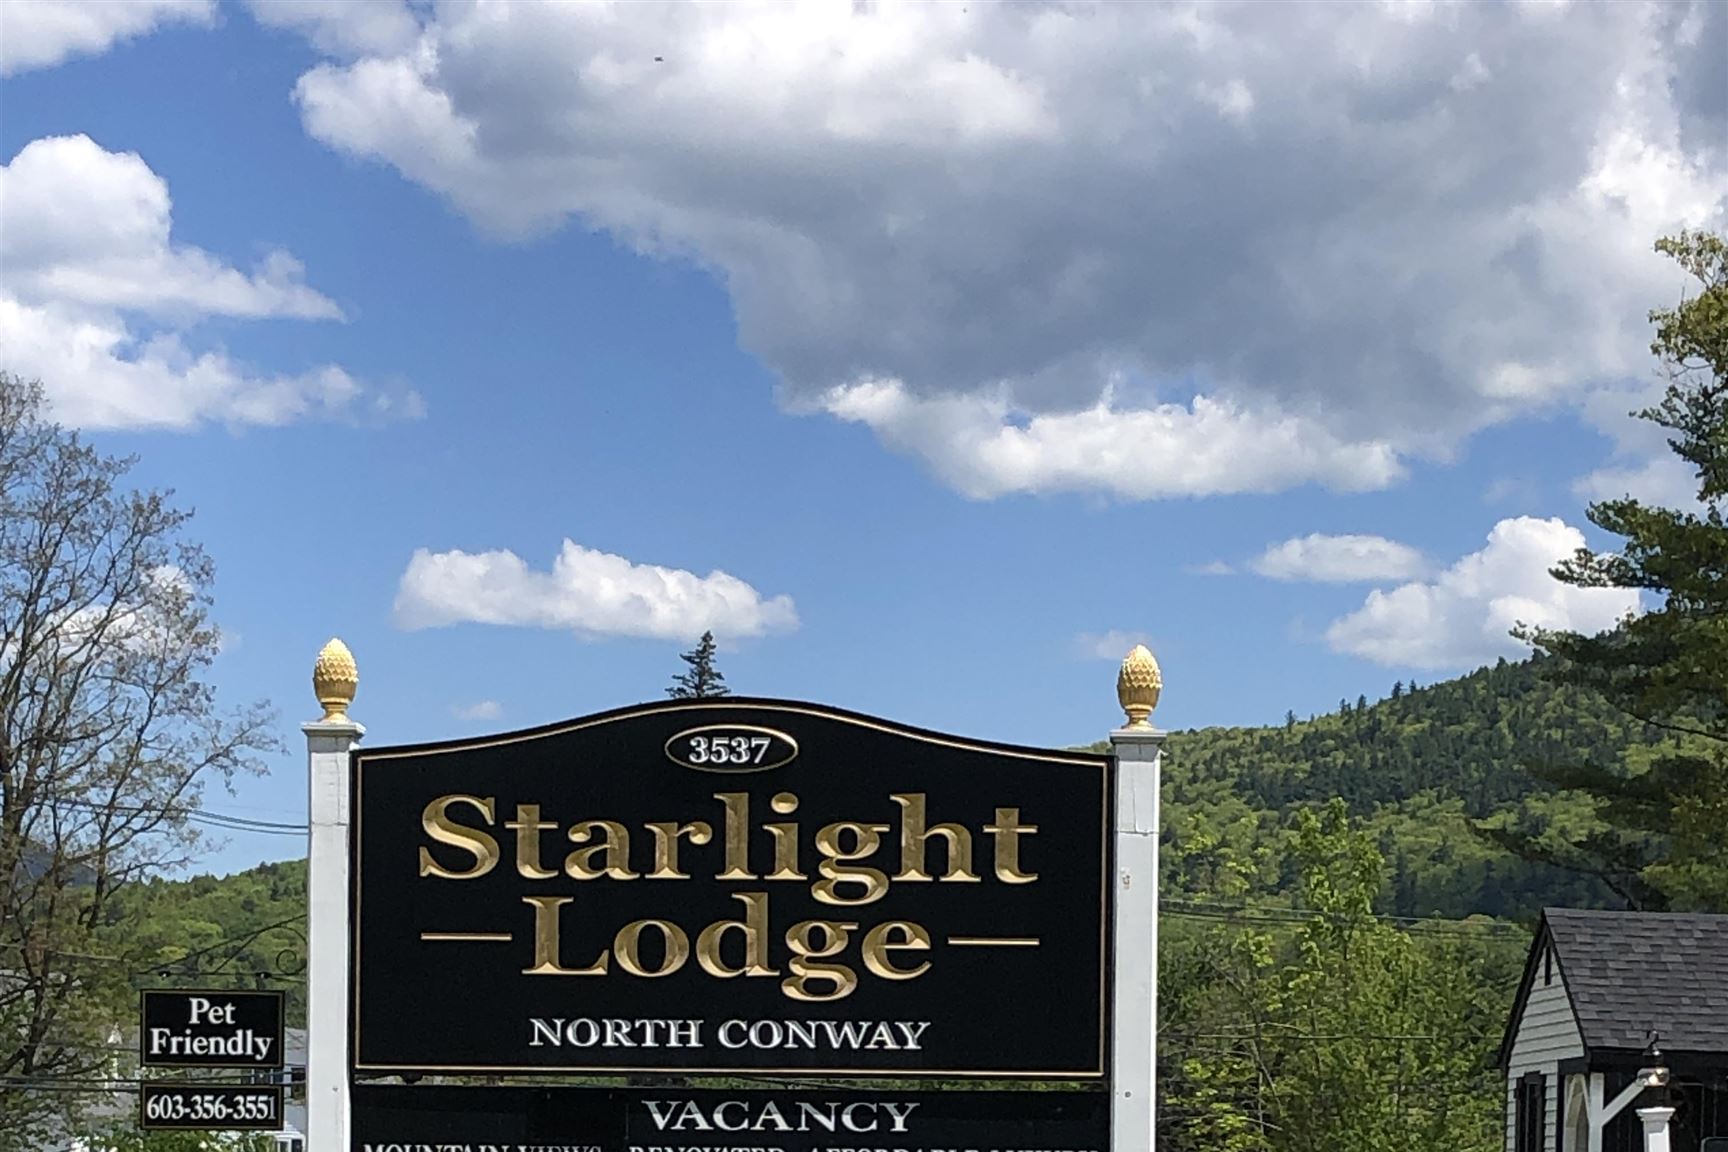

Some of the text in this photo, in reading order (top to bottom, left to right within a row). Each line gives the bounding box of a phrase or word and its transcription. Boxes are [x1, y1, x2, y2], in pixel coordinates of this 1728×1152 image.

[688, 736, 771, 763] 3537
[420, 793, 1037, 907] Starlight
[522, 892, 931, 1001] Lodge
[189, 998, 235, 1024] Pet
[150, 1028, 273, 1060] Friendly
[529, 1018, 931, 1049] NORTH CONWAY
[147, 1095, 275, 1119] 603-356-3551
[642, 1101, 919, 1132] VACANCY
